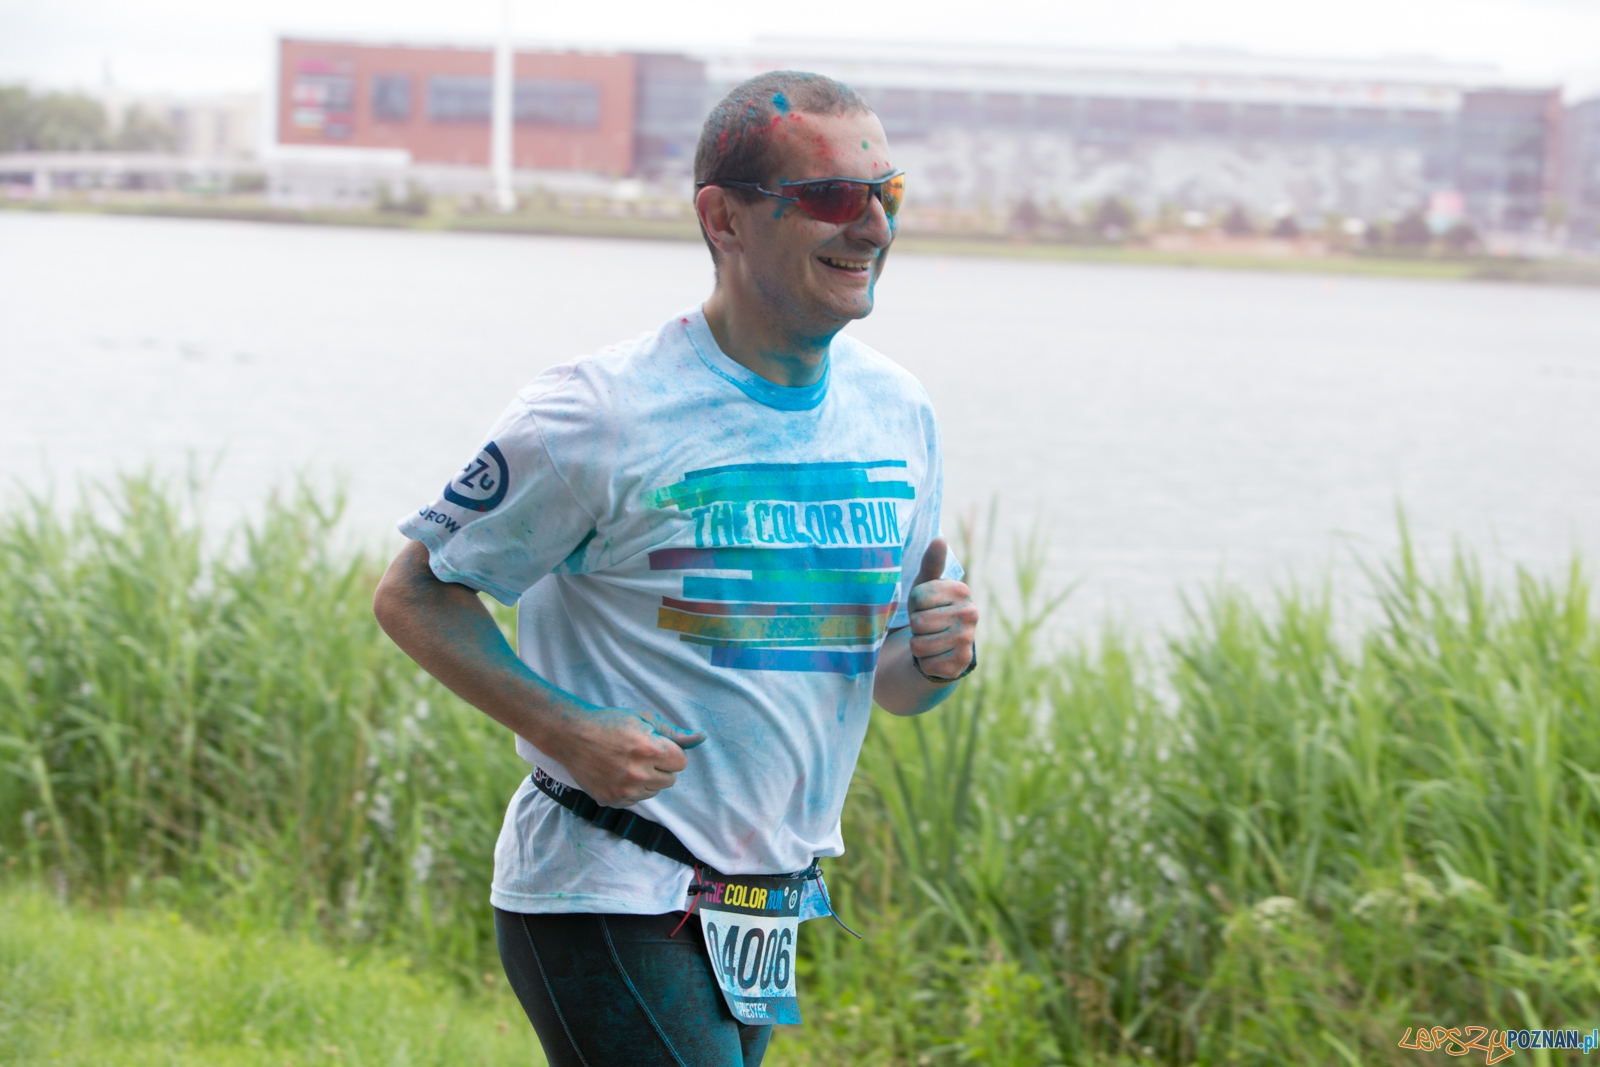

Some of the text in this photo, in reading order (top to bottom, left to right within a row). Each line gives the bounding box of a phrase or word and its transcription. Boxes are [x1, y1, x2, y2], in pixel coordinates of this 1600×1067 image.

[692, 501, 900, 548] THE COLOR RUN
[724, 883, 768, 909] COLOR
[766, 889, 784, 910] RUN
[707, 921, 792, 990] 04006
